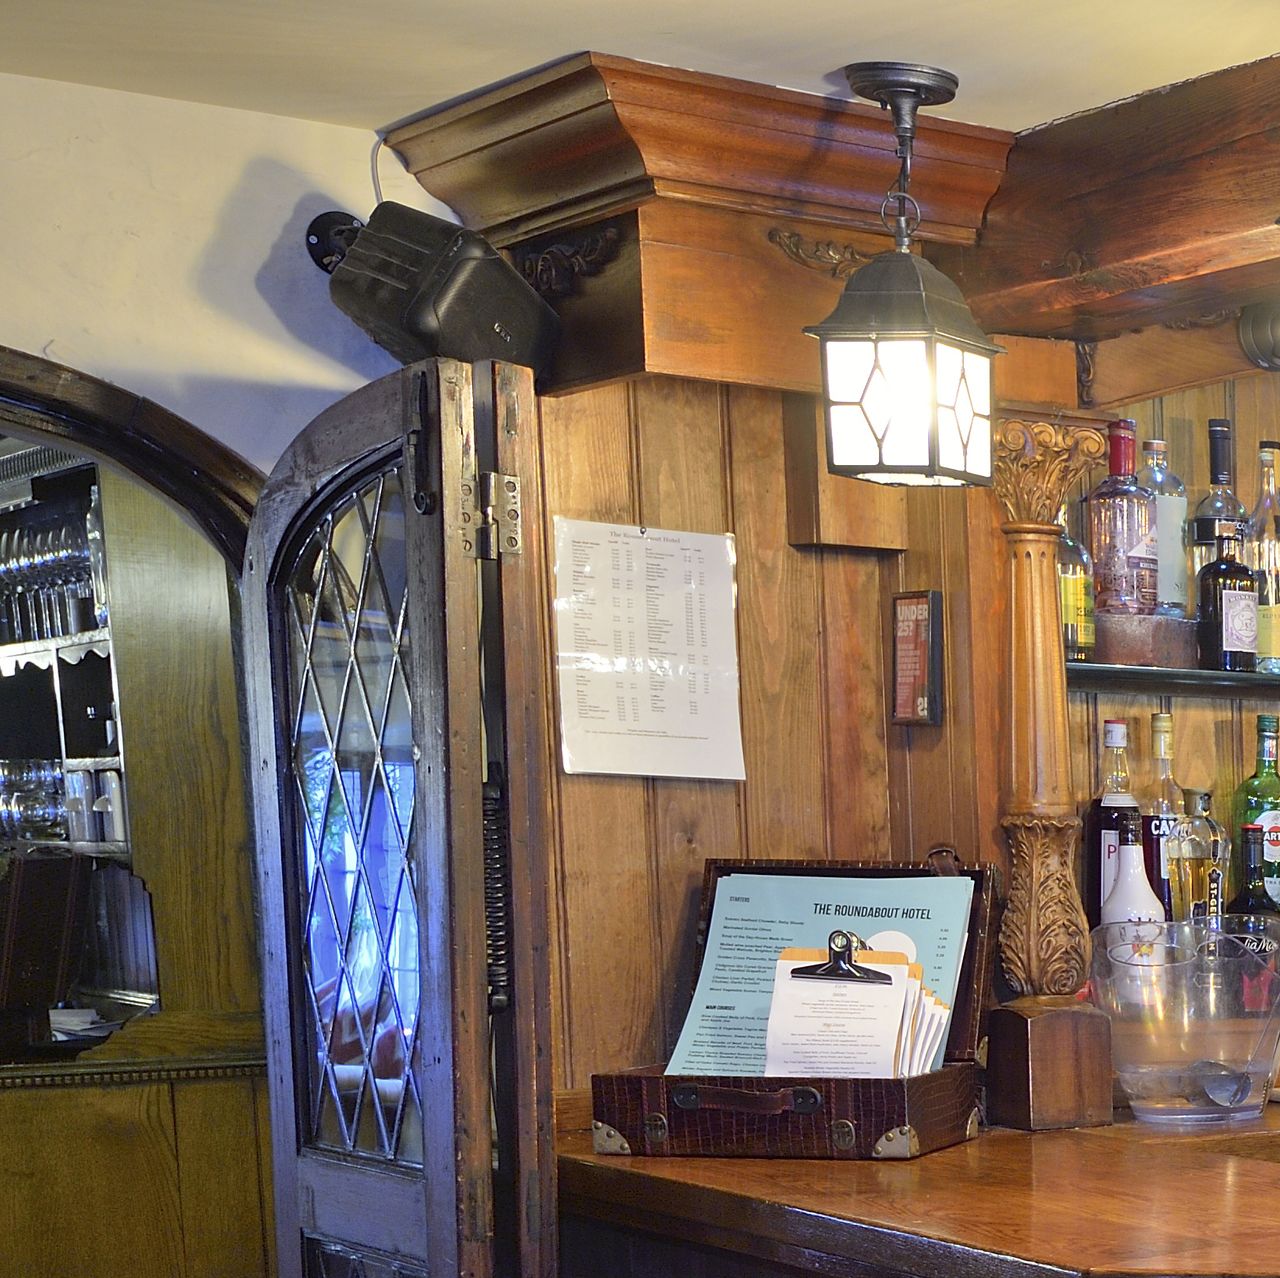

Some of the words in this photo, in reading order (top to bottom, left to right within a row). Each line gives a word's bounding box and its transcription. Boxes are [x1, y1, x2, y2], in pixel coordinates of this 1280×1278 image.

[813, 902, 832, 915] THE
[834, 904, 900, 919] ROUNDABOUT
[901, 908, 932, 920] HOTEL
